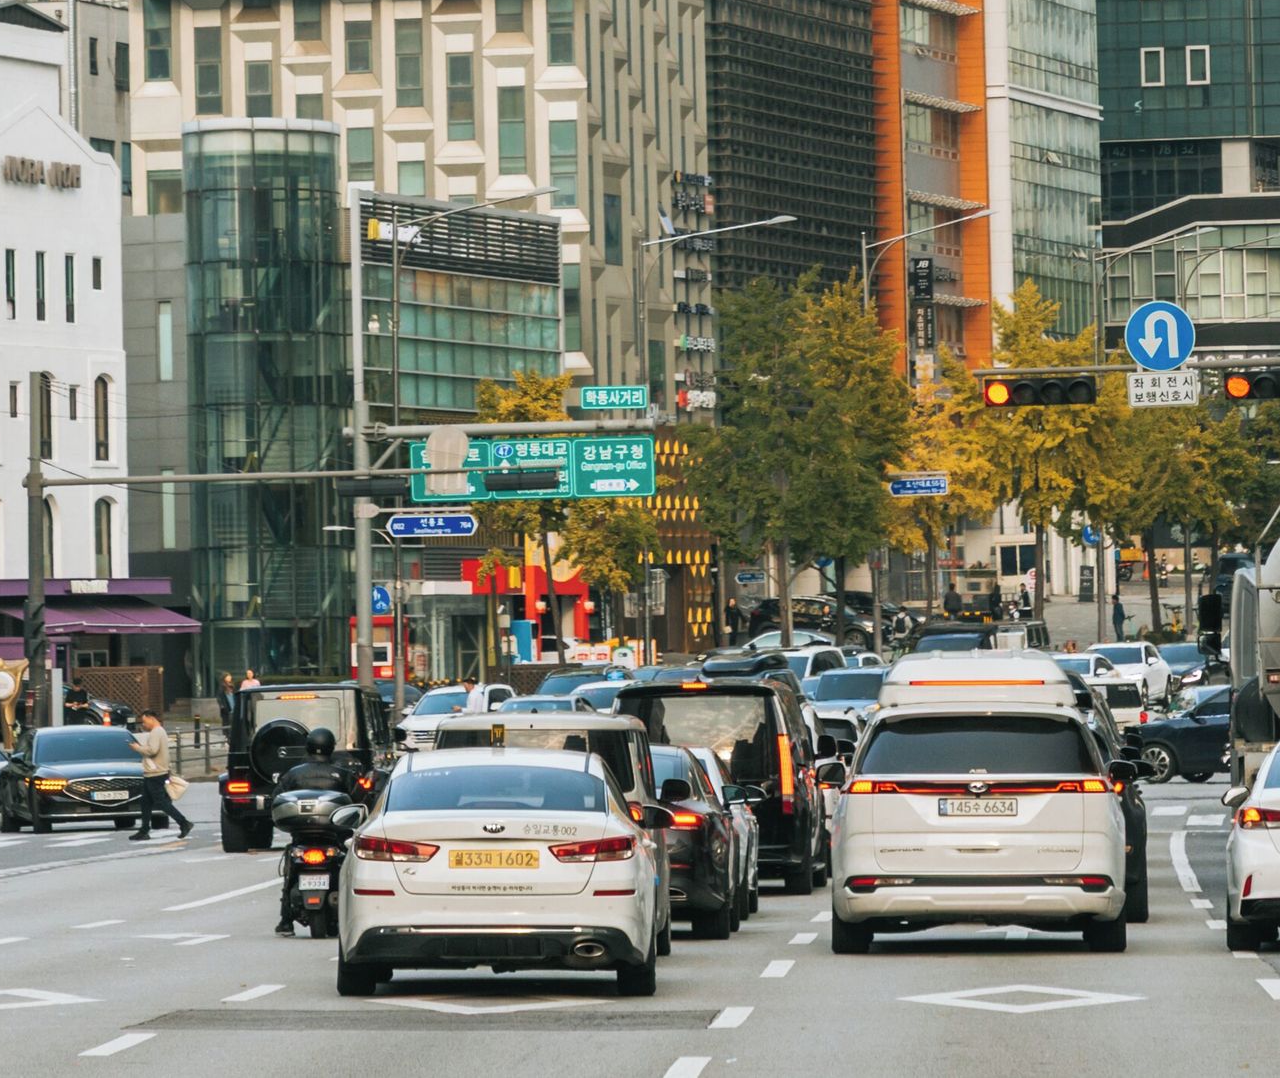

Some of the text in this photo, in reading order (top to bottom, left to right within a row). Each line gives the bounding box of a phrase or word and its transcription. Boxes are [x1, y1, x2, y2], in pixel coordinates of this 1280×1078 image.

[585, 389, 644, 406] 학동사거리
[1133, 390, 1195, 403] 보행신호시
[498, 447, 510, 456] 47
[515, 442, 568, 457] 영동대교
[583, 444, 645, 461] 강남구청
[949, 801, 1014, 814] 145수 6634
[497, 851, 535, 867] 1602
